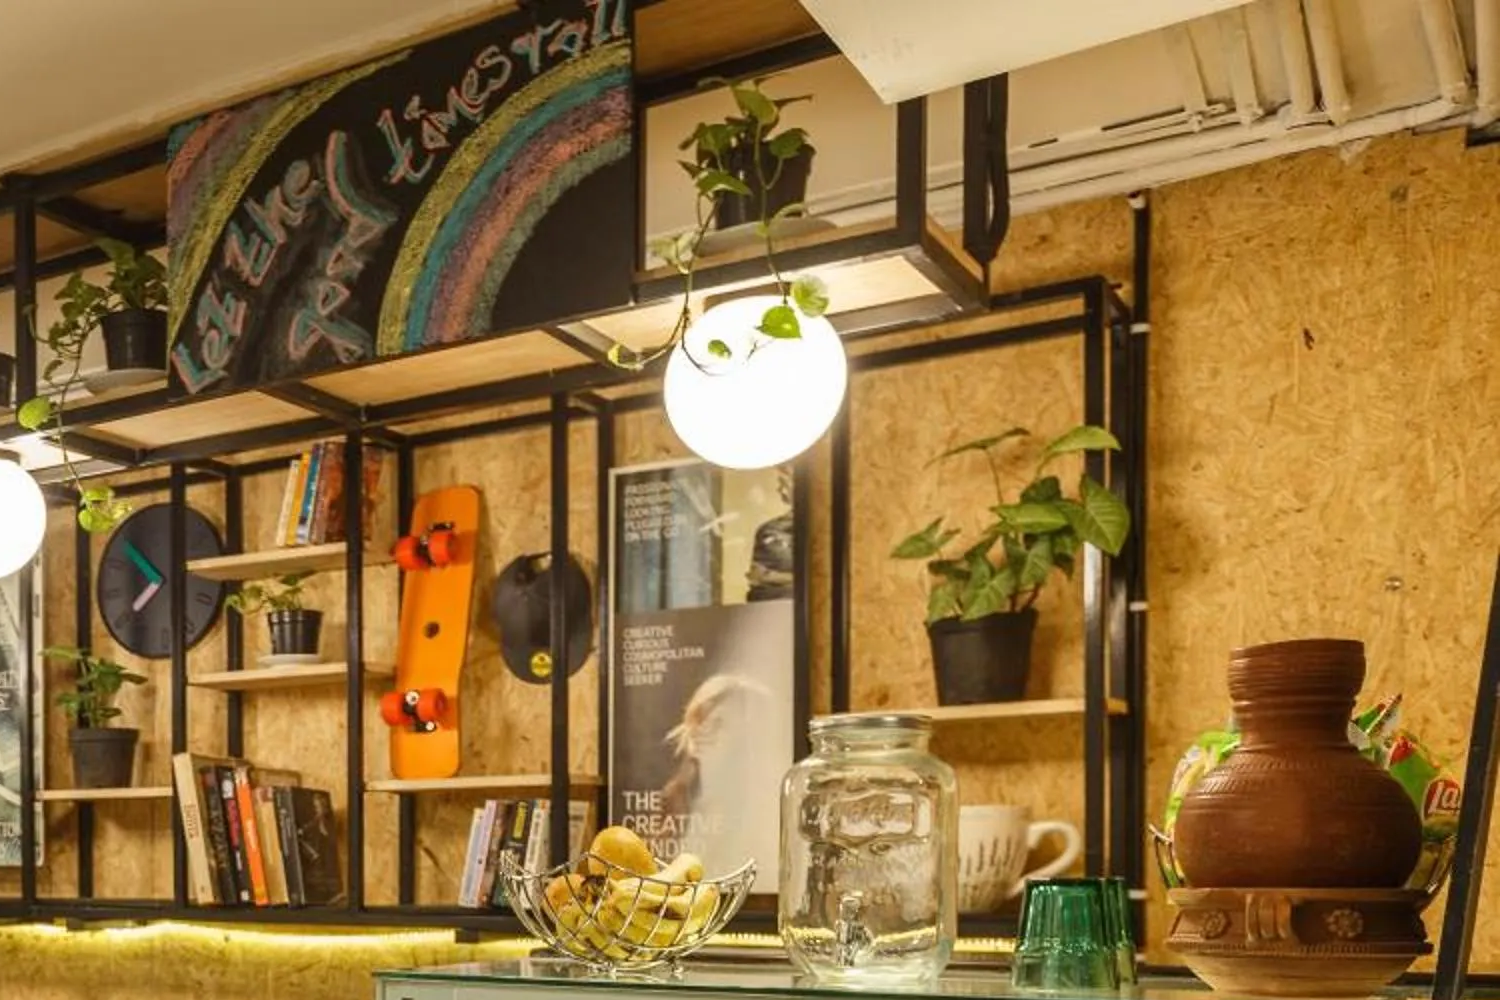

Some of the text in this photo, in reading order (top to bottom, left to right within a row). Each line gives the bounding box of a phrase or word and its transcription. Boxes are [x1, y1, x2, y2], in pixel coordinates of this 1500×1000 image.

[376, 44, 514, 185] times
[622, 646, 706, 663] COSMOPOLITAN
[622, 789, 662, 812] THE
[1427, 780, 1460, 815] La
[621, 813, 726, 836] CREATIVE
